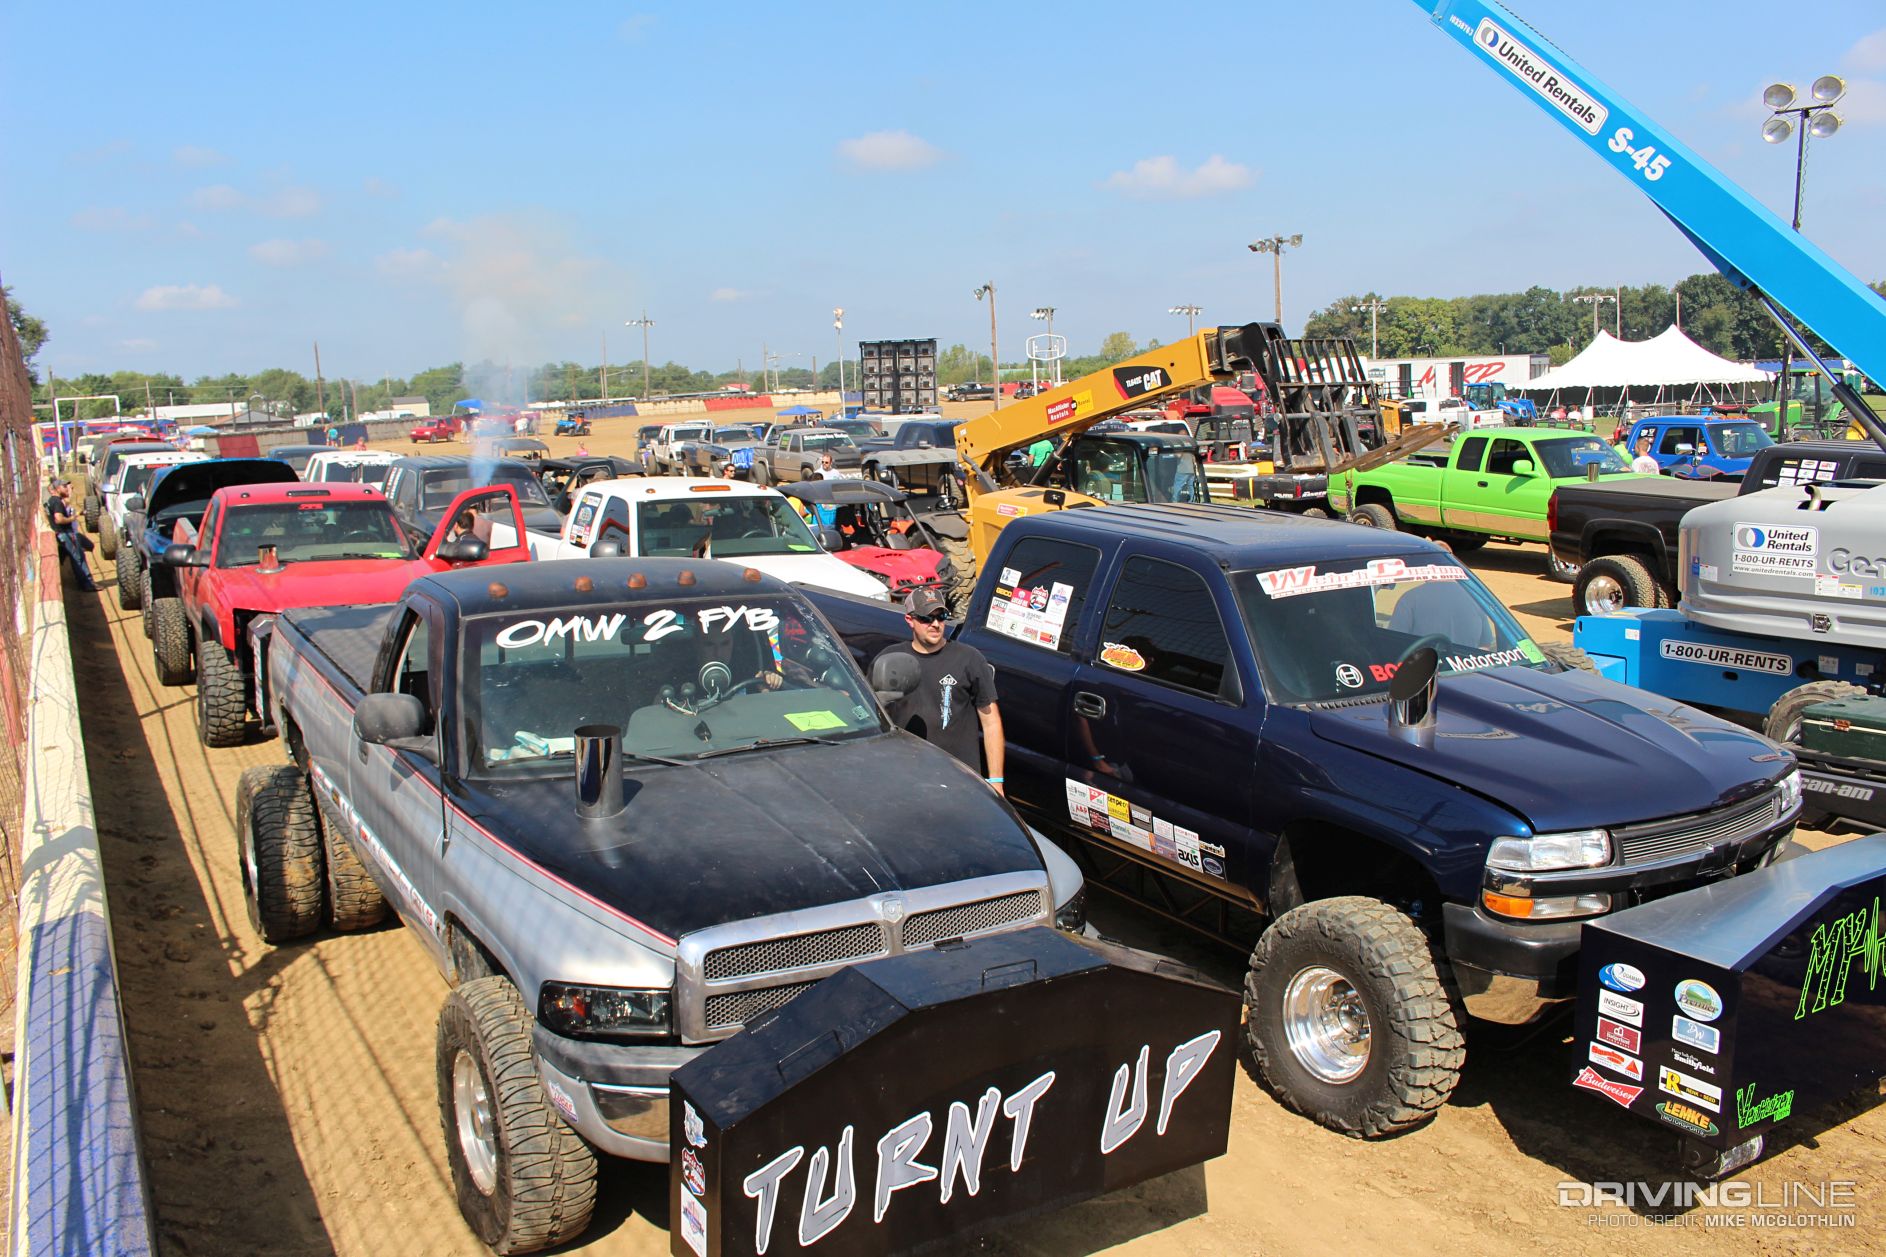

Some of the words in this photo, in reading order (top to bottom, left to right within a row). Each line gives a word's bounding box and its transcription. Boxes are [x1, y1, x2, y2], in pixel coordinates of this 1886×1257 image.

[1499, 41, 1546, 83] United
[1543, 76, 1596, 124] Rentals
[1608, 127, 1672, 181] S-45
[1143, 369, 1162, 391] CAT
[1767, 540, 1812, 552] Rentals
[1768, 529, 1809, 541] United
[1734, 554, 1814, 568] 1-800-UR-RENTS
[1734, 566, 1814, 577] www.unitedrentals.com
[495, 613, 627, 648] OMW
[643, 609, 684, 641] 2
[698, 605, 781, 633] FYB
[1664, 644, 1788, 671] 1-800-UR-RENTS
[1800, 778, 1873, 800] can-am
[1178, 848, 1199, 866] axis
[1603, 997, 1630, 1011] INSIGHT
[1678, 993, 1719, 1014] Premier
[1674, 1053, 1716, 1075] Smithfield
[1580, 1071, 1636, 1101] Budweiser
[1664, 1101, 1710, 1130] LEMKE
[743, 1071, 1056, 1256] TURNT
[1100, 1029, 1222, 1155] UP
